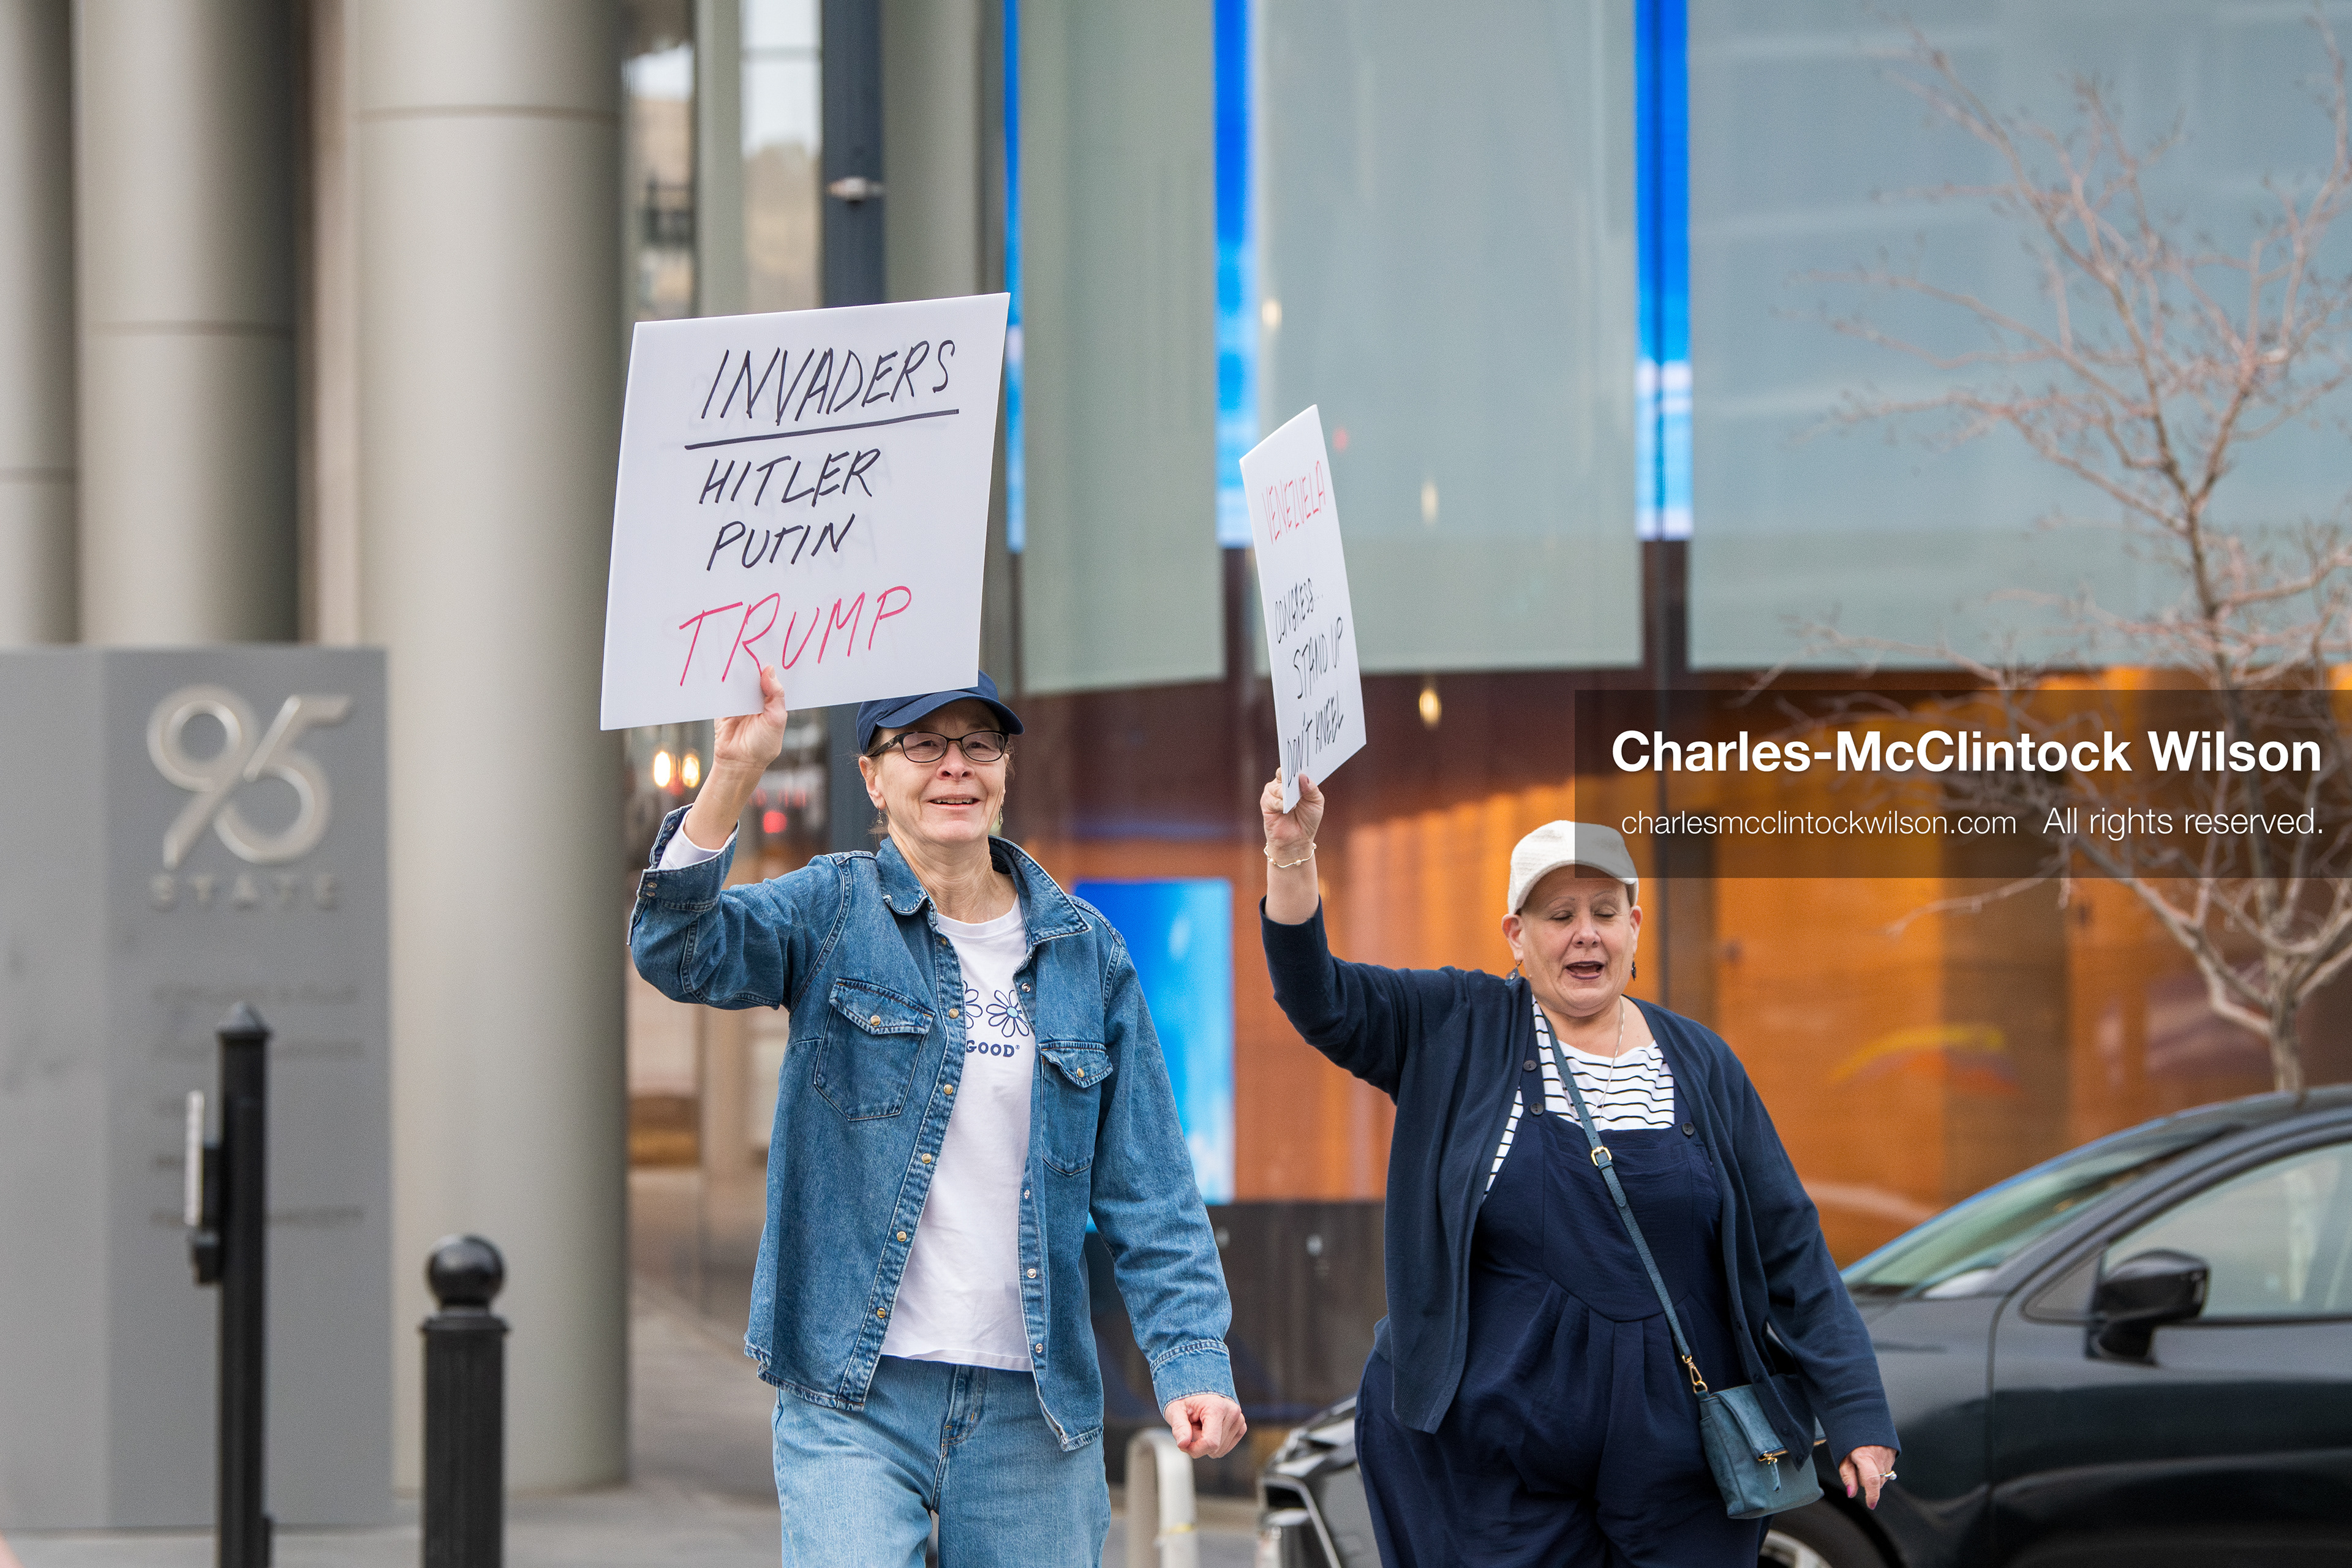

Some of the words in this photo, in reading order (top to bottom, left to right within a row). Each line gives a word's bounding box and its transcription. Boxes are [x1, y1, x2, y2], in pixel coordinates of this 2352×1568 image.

[701, 339, 956, 426] INVADERS
[698, 448, 881, 508] HITLER
[1262, 461, 1326, 545] VENEZUELA
[706, 513, 856, 571] PUTIN
[679, 586, 912, 687] TRUMP
[1293, 631, 1328, 699] STAND
[1331, 616, 1343, 668] UP
[146, 683, 352, 870] 95
[1287, 711, 1313, 788] DON'T
[1315, 690, 1344, 754] KNEEL
[149, 873, 341, 913] STATE
